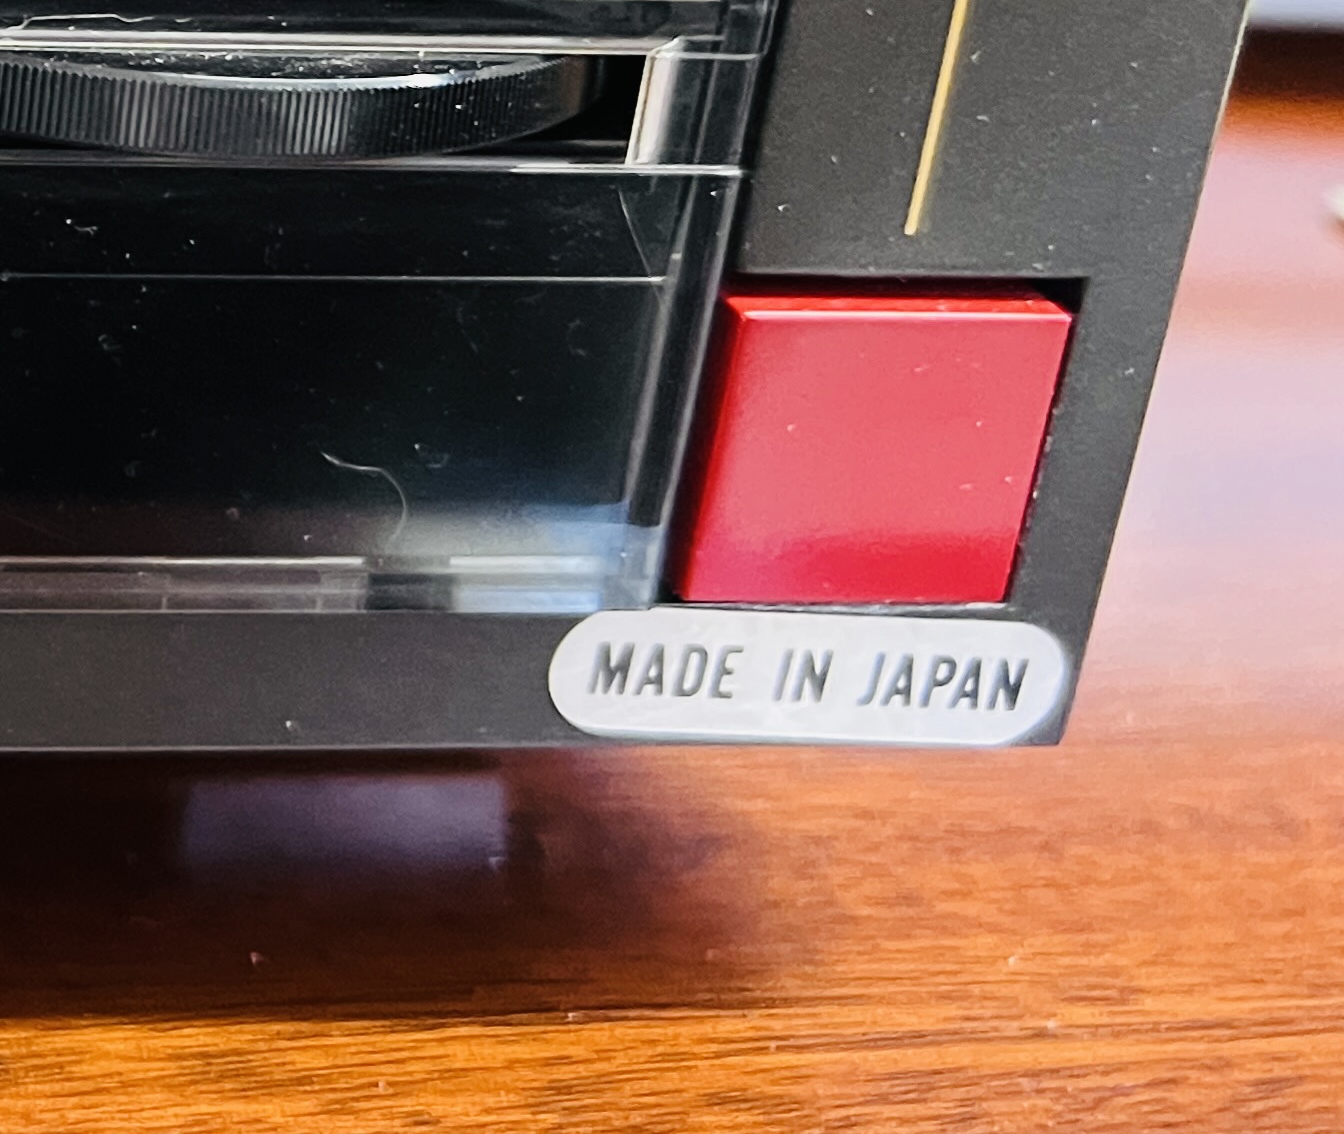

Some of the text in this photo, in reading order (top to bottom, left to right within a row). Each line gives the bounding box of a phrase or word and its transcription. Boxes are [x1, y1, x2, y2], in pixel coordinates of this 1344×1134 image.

[586, 640, 1029, 712] MADE IN JAPAN
